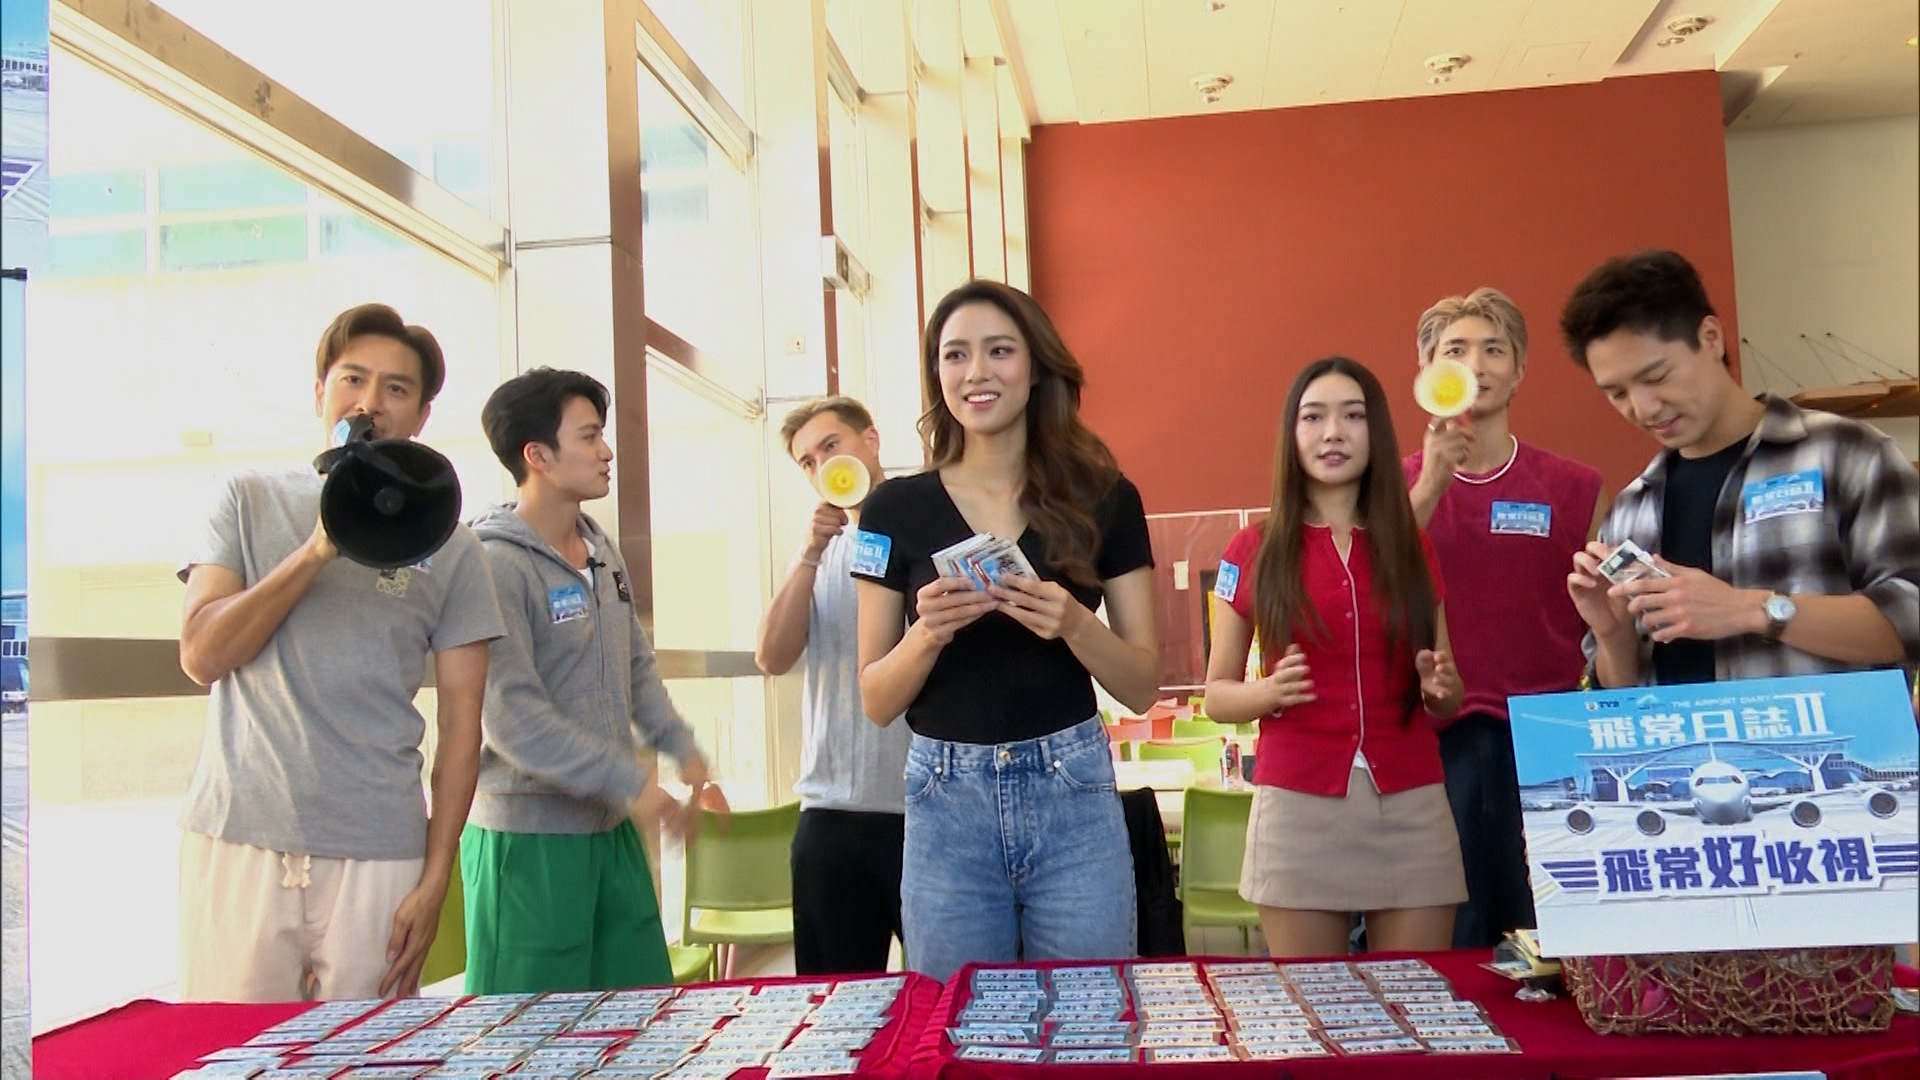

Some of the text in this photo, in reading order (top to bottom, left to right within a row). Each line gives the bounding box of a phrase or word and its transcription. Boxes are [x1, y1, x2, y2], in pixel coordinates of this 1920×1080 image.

[1671, 700, 1692, 708] THE
[1601, 835, 1873, 893] 飛常好收視
